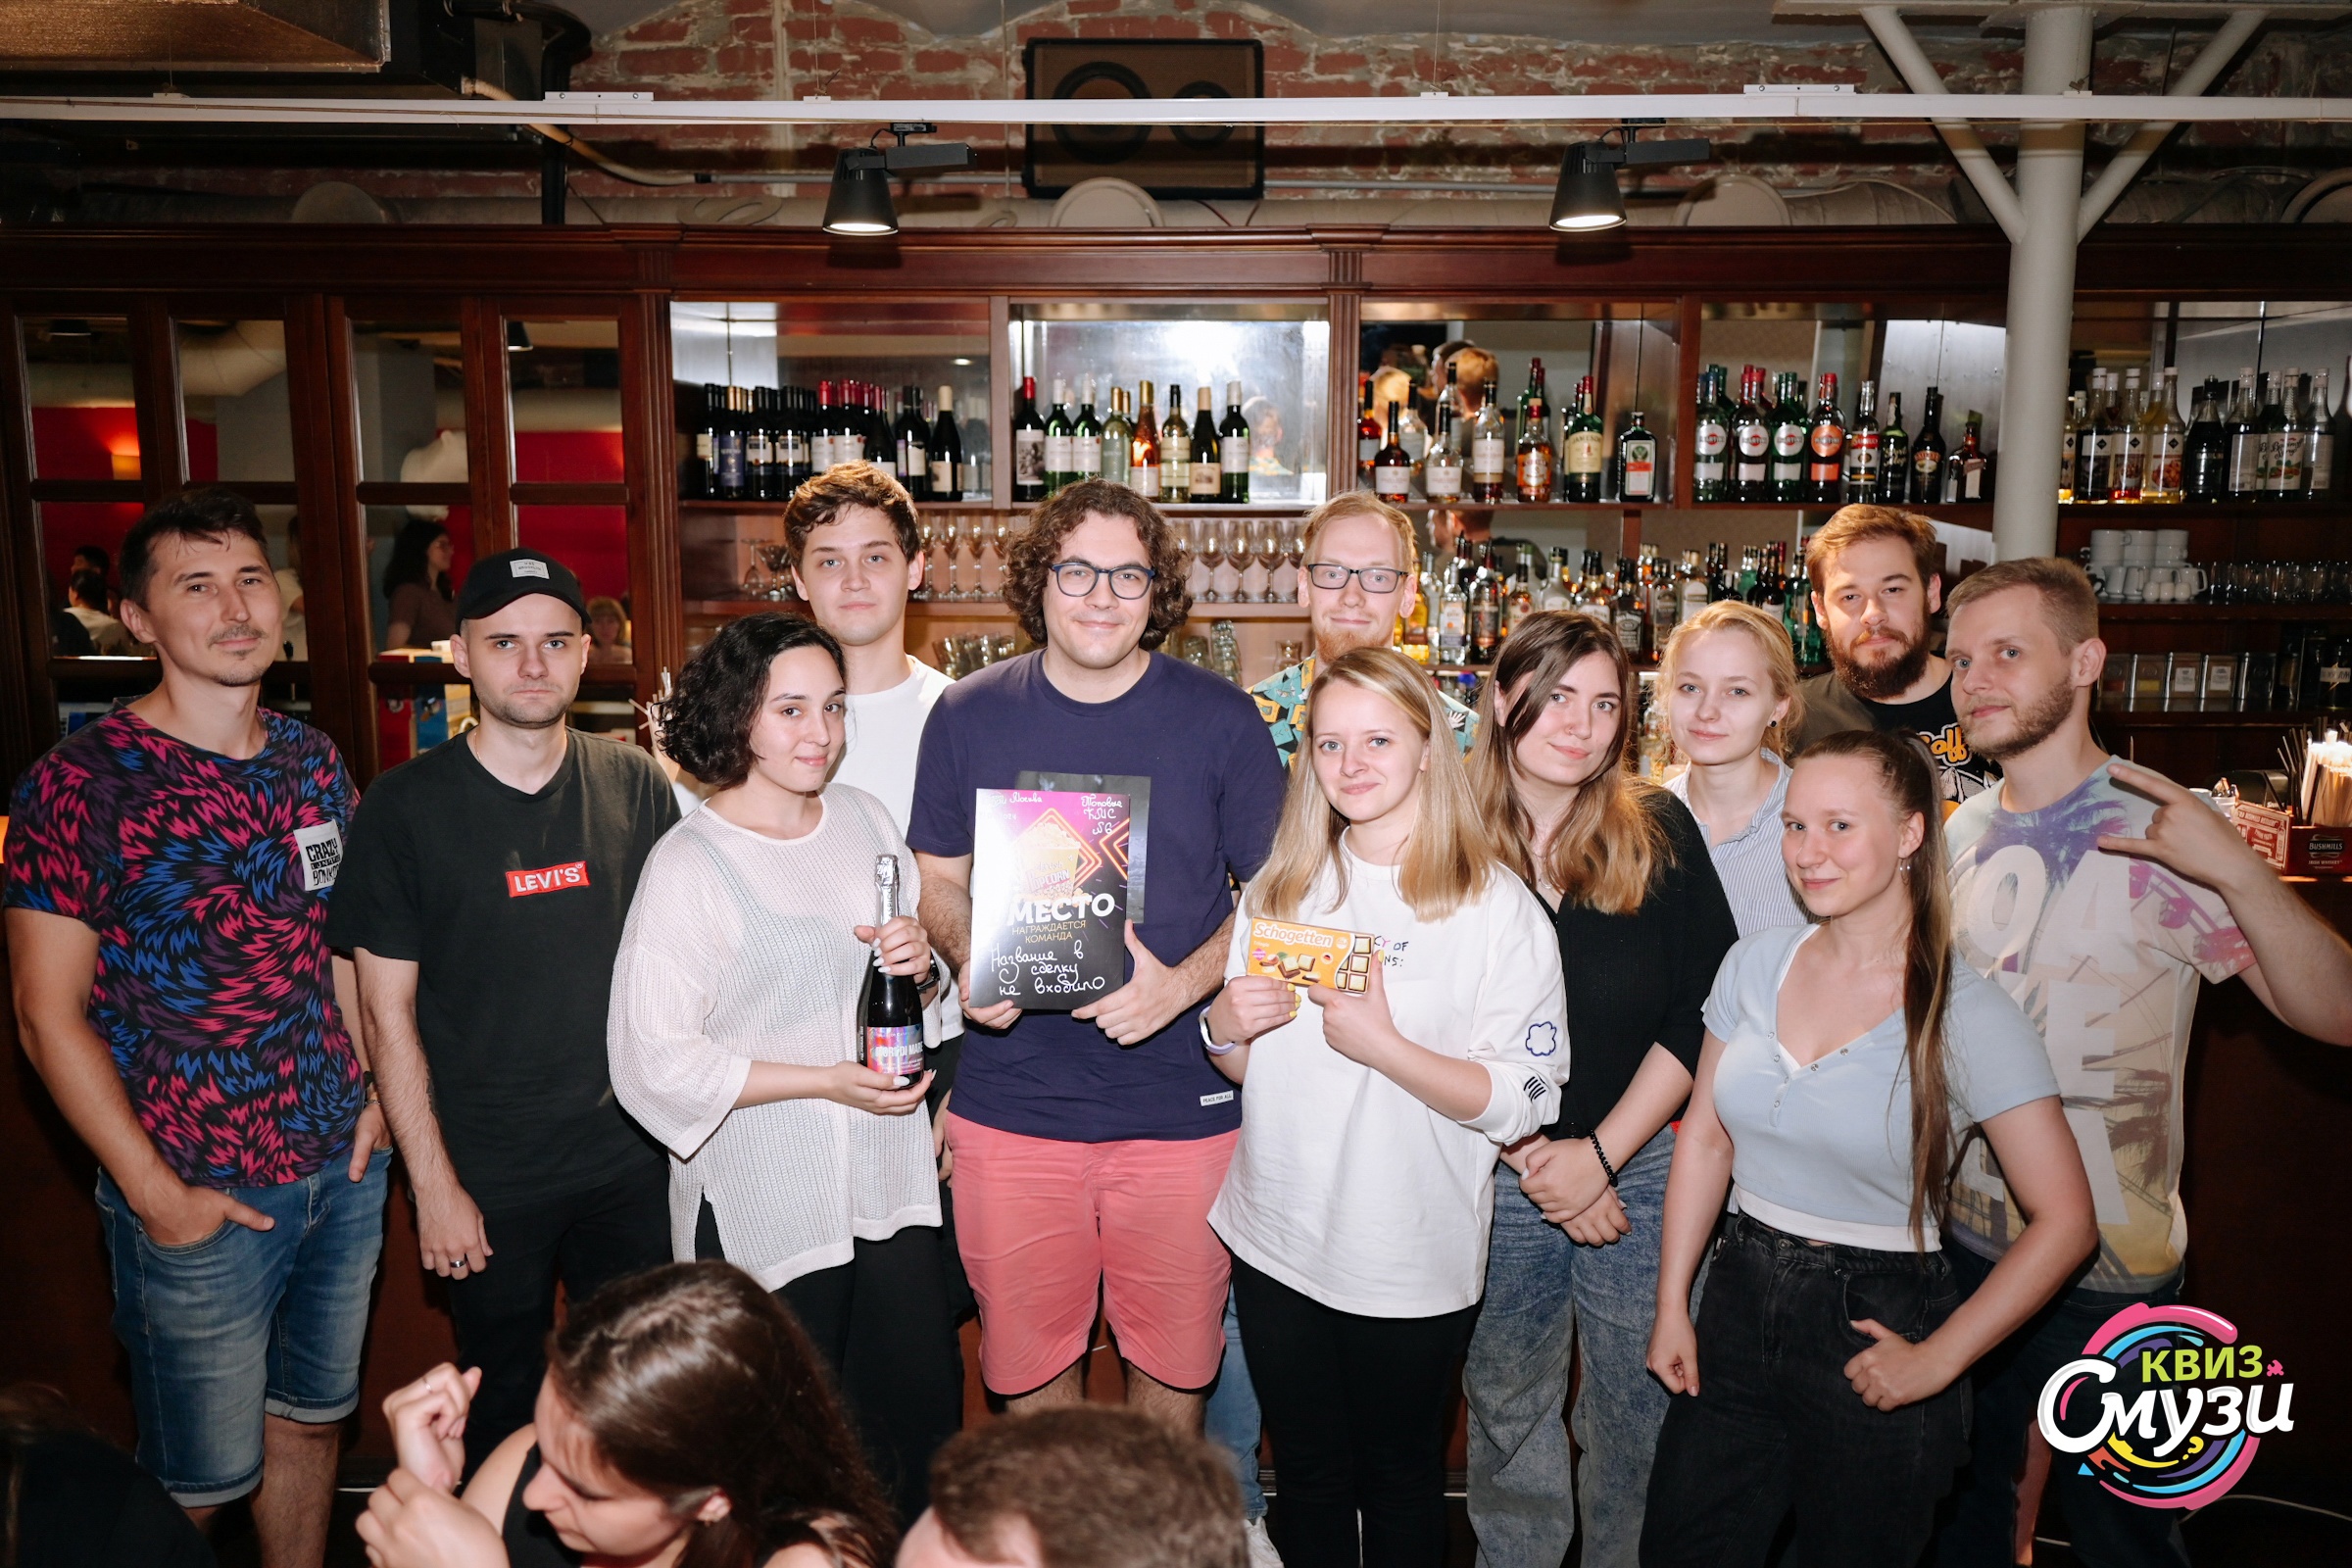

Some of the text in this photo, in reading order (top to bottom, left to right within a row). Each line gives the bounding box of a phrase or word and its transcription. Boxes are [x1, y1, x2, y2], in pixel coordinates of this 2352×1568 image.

[306, 837, 338, 862] CRAZY
[2309, 842, 2343, 851] BUSHMILLS
[514, 865, 581, 893] LEVI'S
[1007, 893, 1115, 926] МЕСТО
[1011, 920, 1087, 936] НАГРАЖДАЕТСЯ
[1025, 931, 1073, 944] КОМАНДА
[1254, 922, 1333, 947] Schogetten
[1393, 941, 1409, 952] OF
[990, 942, 1058, 984] Название
[1031, 961, 1079, 985] сделку
[1000, 985, 1021, 996] не
